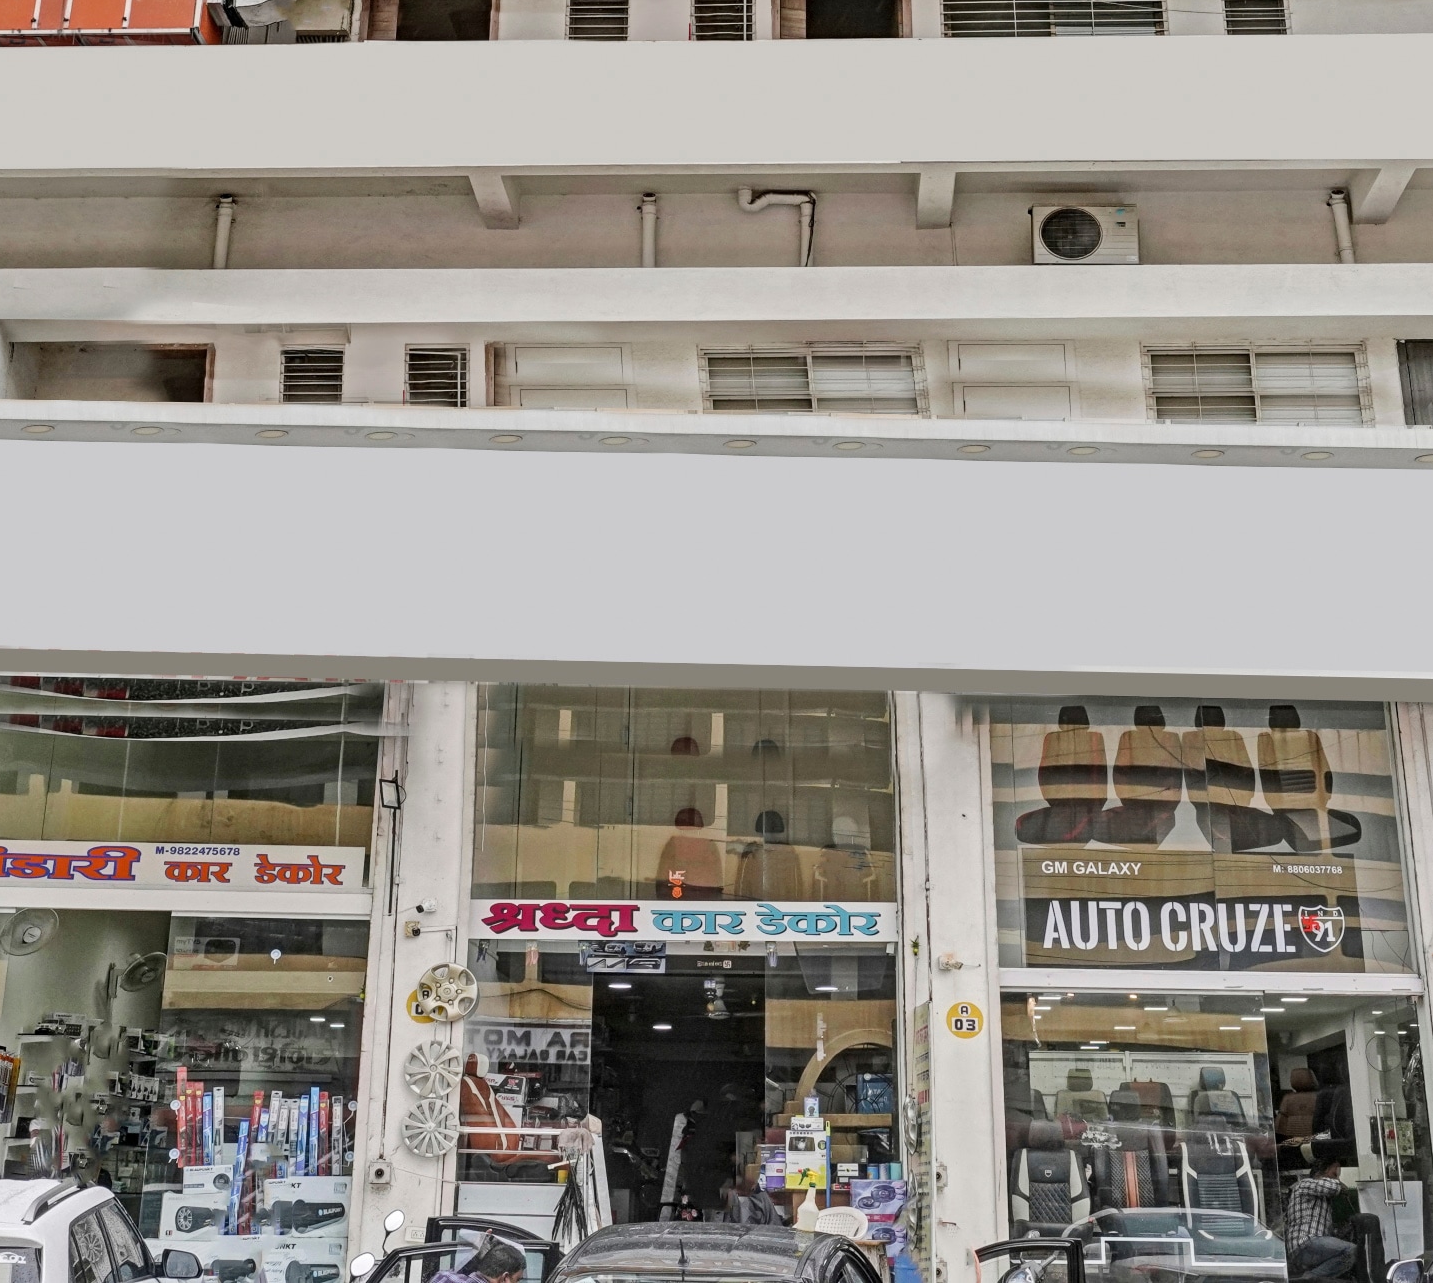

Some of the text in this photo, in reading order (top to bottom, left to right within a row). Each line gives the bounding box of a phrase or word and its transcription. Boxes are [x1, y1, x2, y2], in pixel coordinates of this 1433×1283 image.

[155, 846, 241, 857] M-9822475678
[164, 854, 346, 885] कार डेकोर
[1041, 861, 1142, 875] GM GALAXY
[1287, 865, 1343, 874] 8806037768
[651, 909, 747, 935] कार
[755, 903, 881, 936] डेकोर
[1043, 900, 1297, 953] AUTO CRUZE
[961, 1005, 969, 1015] A
[954, 1018, 976, 1031] 03
